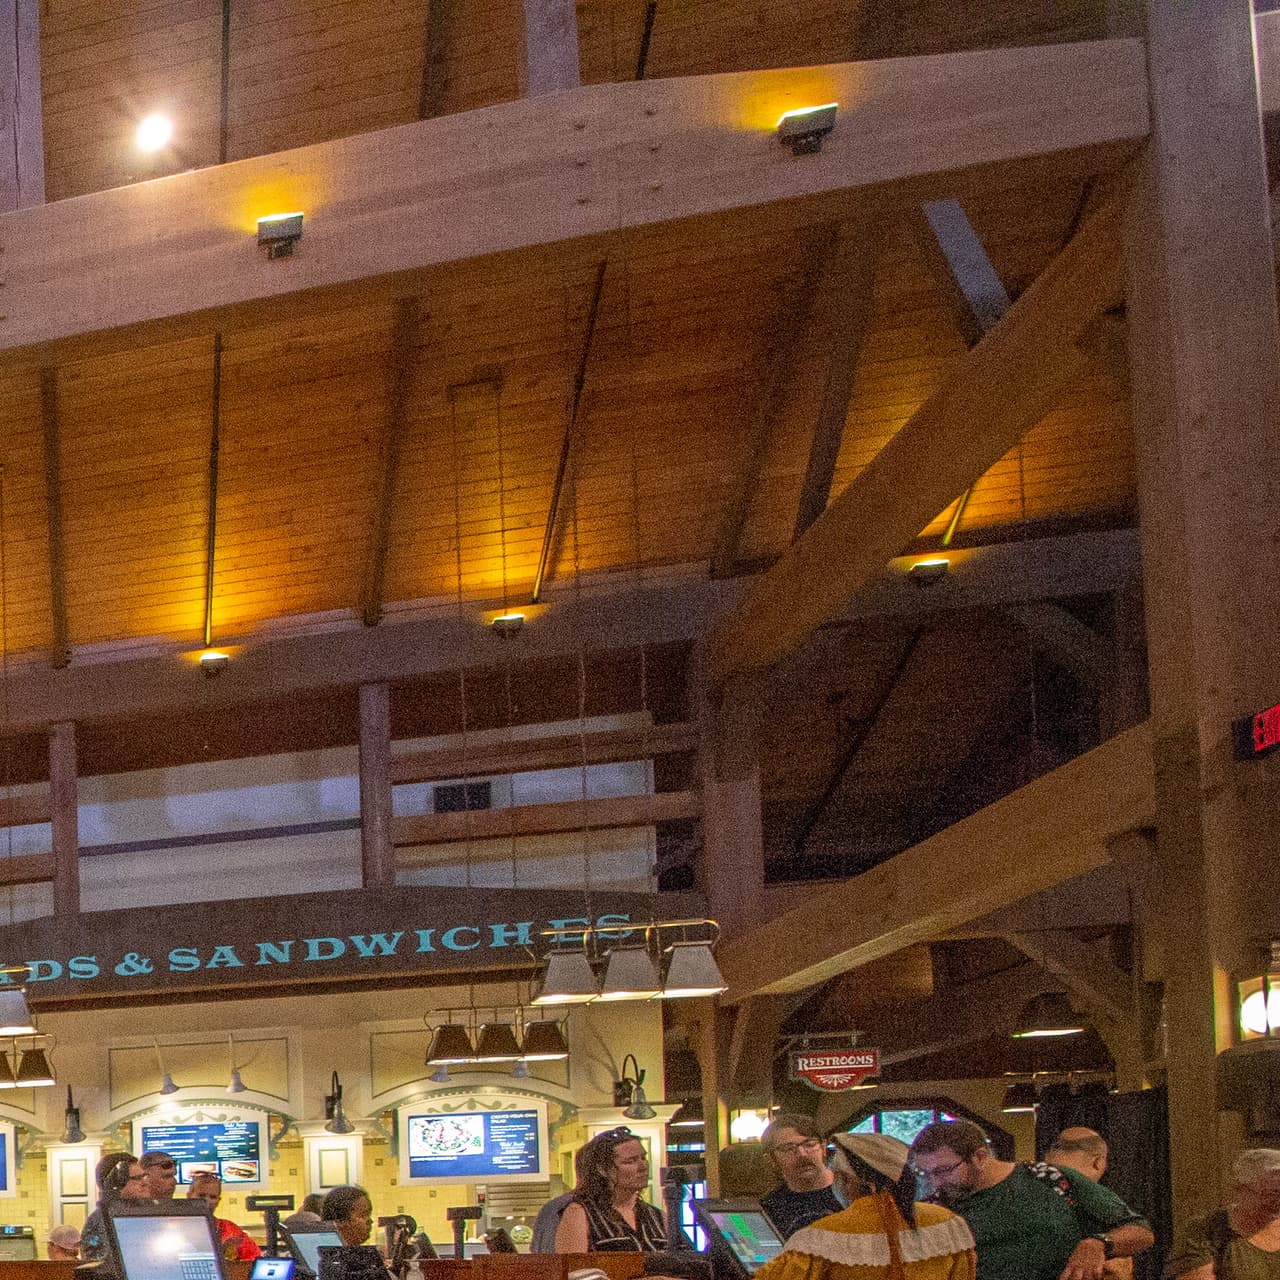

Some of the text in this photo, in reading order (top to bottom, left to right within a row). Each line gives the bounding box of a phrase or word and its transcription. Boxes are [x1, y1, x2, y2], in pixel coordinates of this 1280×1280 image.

[114, 951, 154, 977] &
[167, 913, 635, 973] SANDWICHES
[797, 1054, 874, 1071] RESTROOMS
